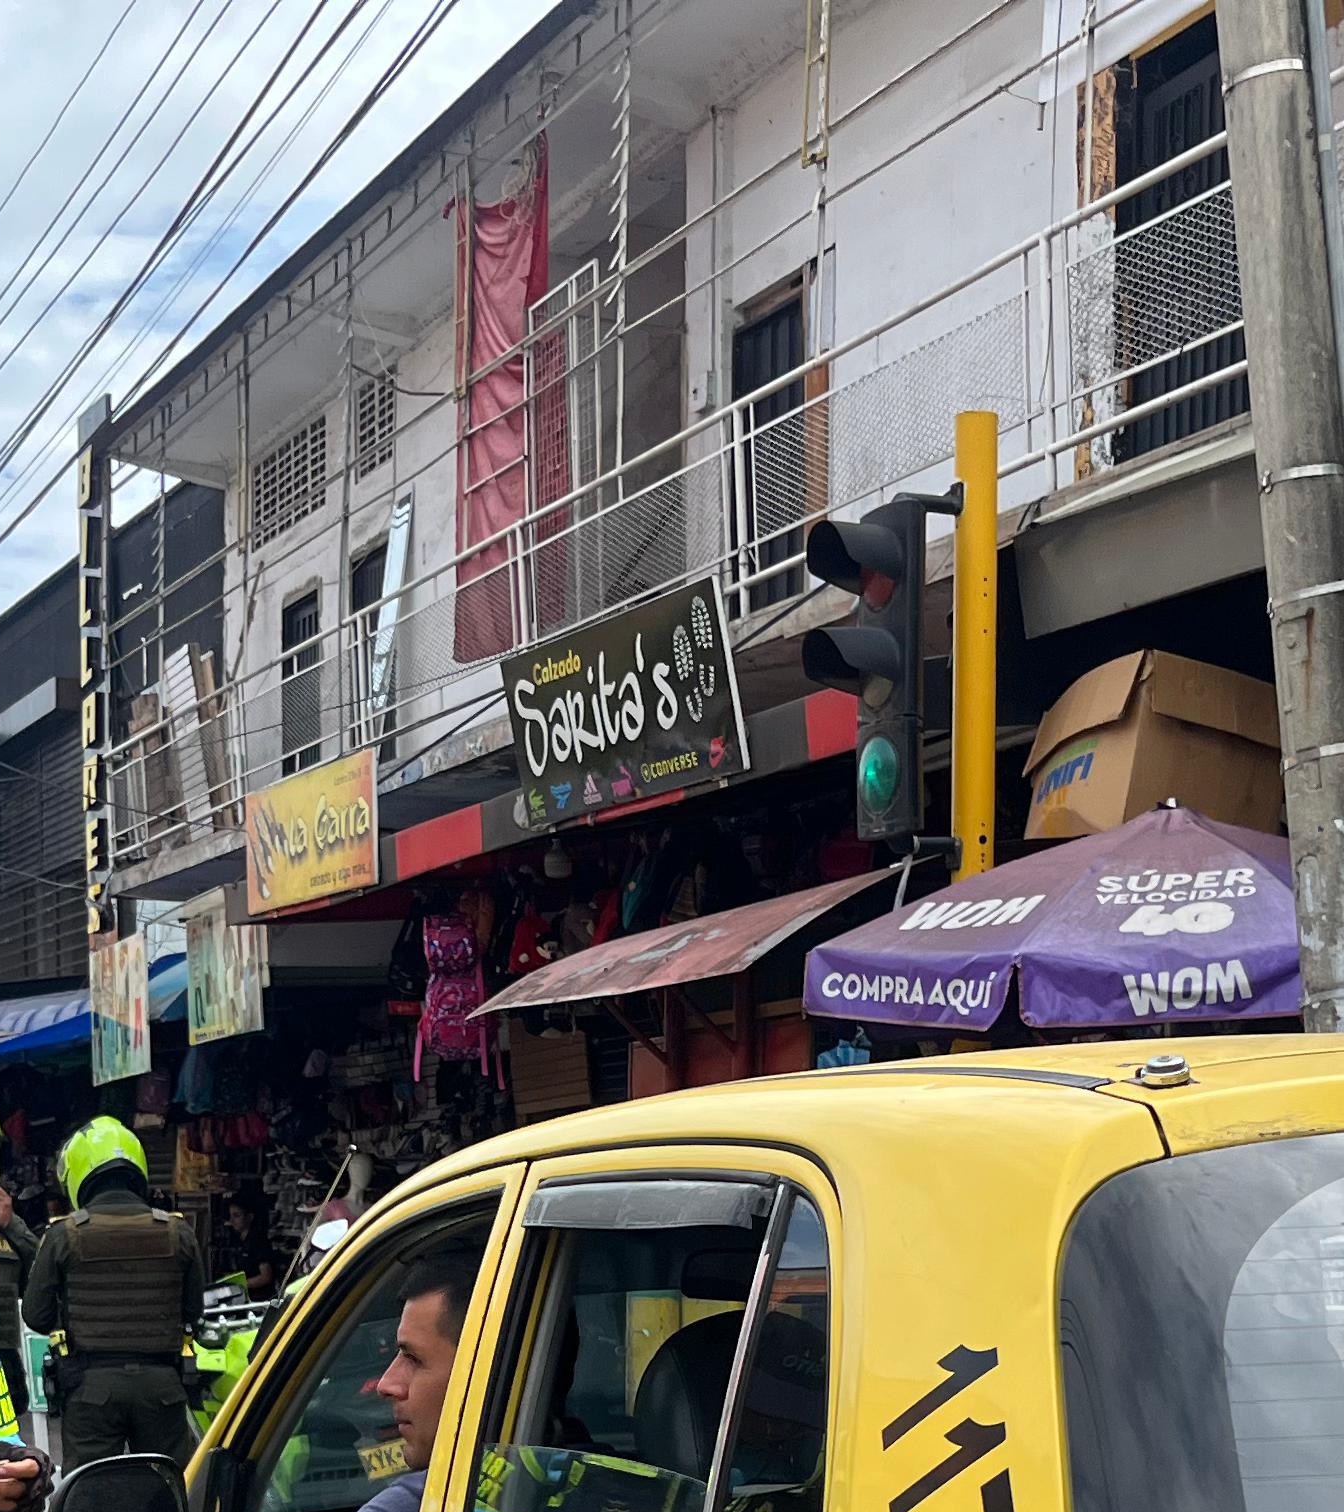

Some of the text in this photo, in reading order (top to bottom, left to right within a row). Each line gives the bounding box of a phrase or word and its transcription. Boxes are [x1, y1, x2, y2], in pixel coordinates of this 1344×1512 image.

[533, 649, 582, 686] Calzado
[78, 444, 102, 935] BILLARES
[650, 751, 699, 779] CONVERSE
[1096, 868, 1255, 894] SÚPER
[1096, 886, 1257, 905] VELOCIDAD
[899, 894, 1047, 930] WOM
[821, 970, 998, 1016] COMPRA AQUÍ
[1122, 958, 1253, 1018] WOM
